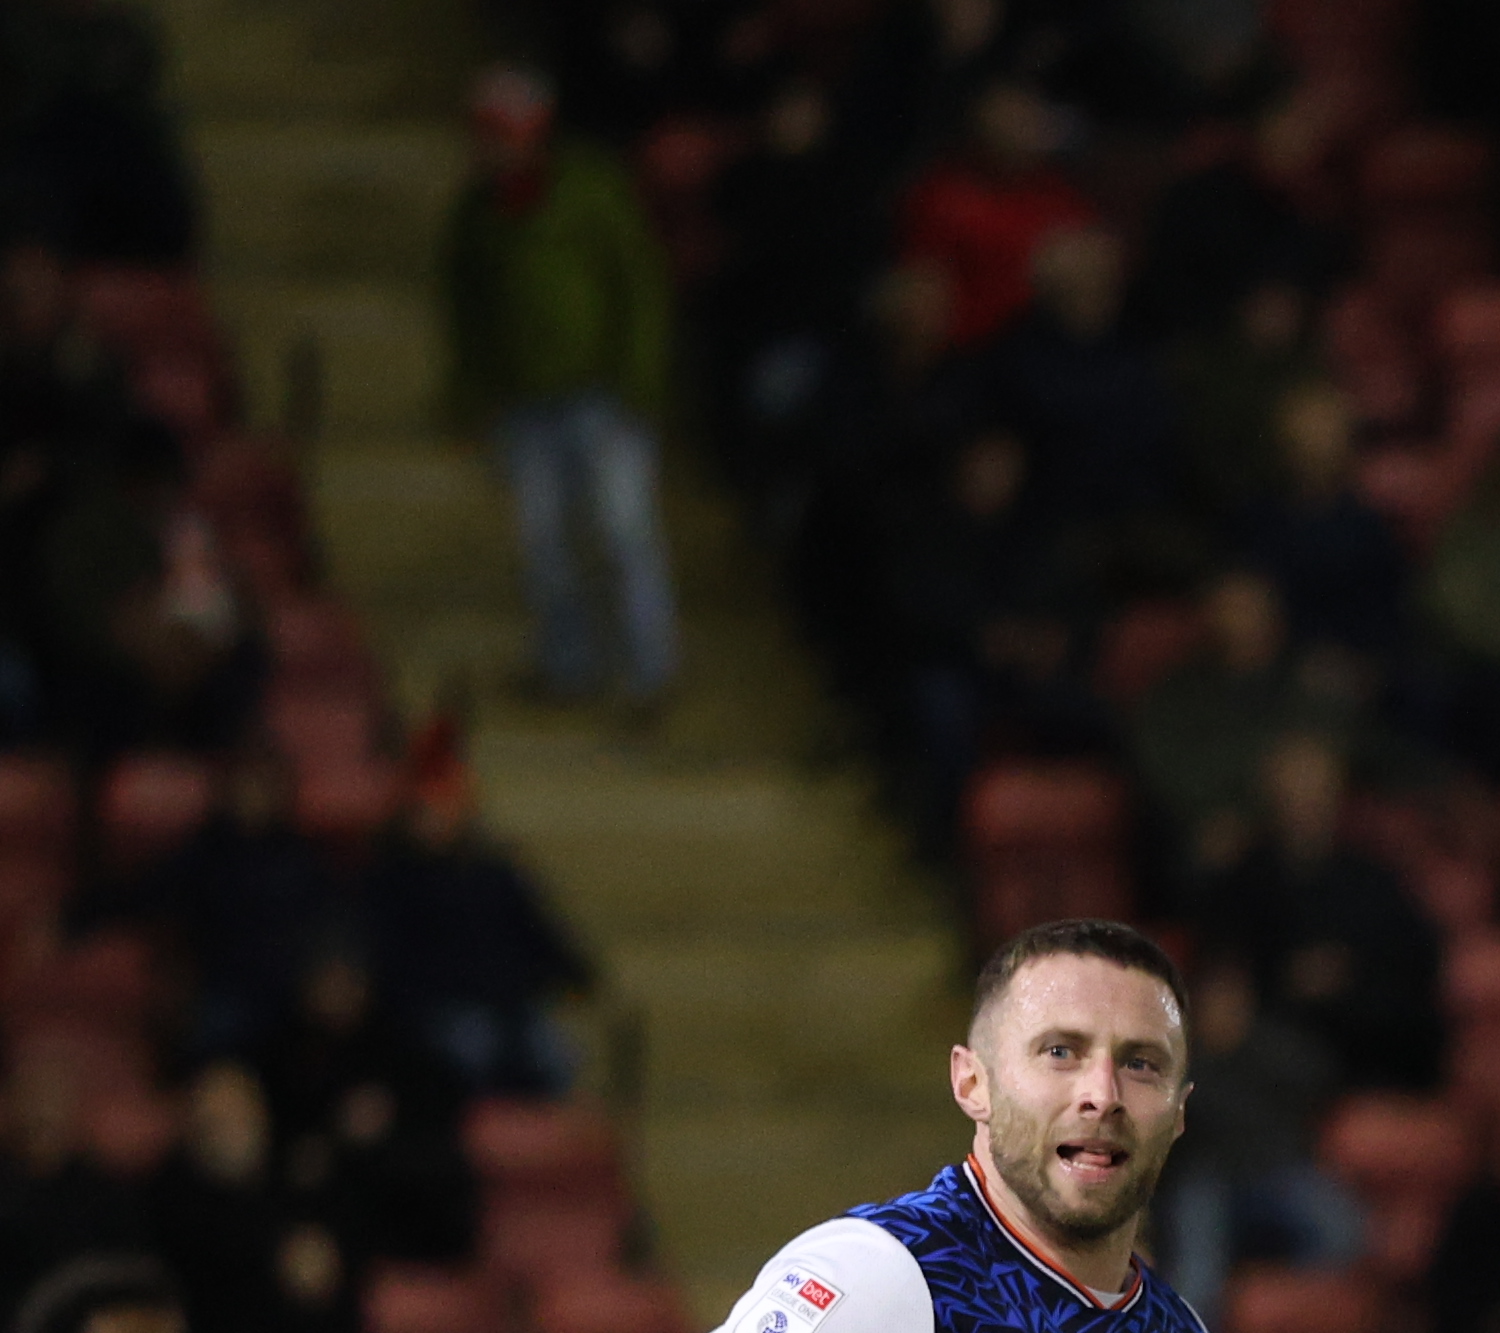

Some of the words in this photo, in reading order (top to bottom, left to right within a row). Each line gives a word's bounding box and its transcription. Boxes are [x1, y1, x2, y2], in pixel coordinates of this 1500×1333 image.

[783, 1273, 805, 1289] sky
[801, 1282, 831, 1306] bet
[798, 1303, 819, 1323] ONE
